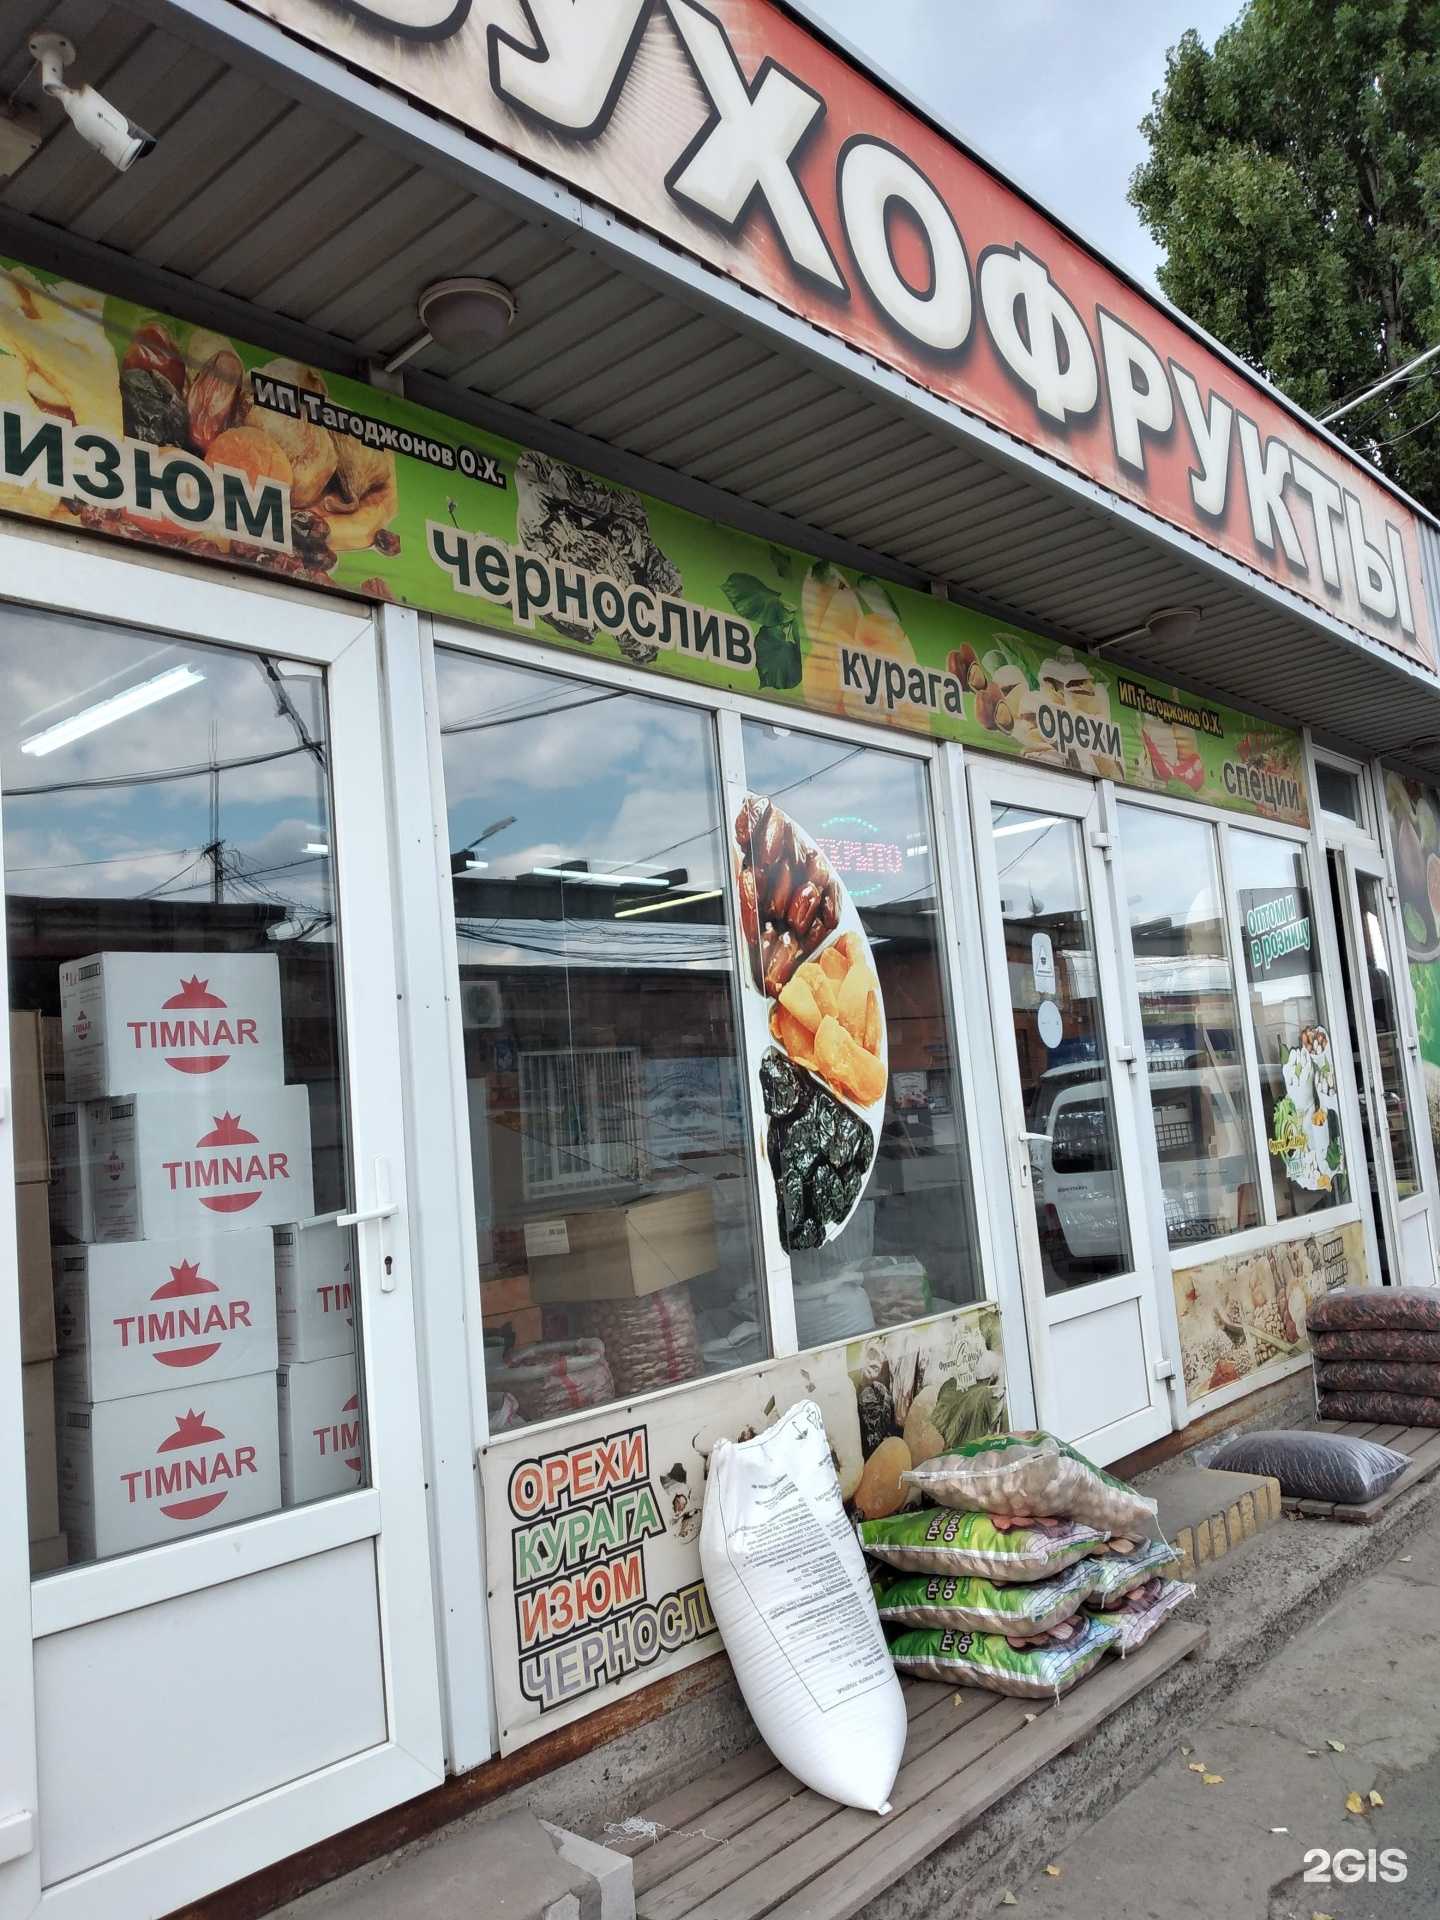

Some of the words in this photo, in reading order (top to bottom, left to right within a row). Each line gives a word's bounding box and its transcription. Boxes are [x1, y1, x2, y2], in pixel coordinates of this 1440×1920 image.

[325, 0, 1418, 639] УХОФРУКТЫ
[255, 378, 298, 414] ИП
[303, 394, 455, 468] Тагоджонов
[841, 648, 963, 715] курага
[1119, 680, 1137, 706] ИП
[1137, 688, 1201, 728] Тагоджонов
[1037, 703, 1122, 758] орехи
[1223, 762, 1300, 812] специи
[126, 1018, 259, 1049] TIMNAR
[162, 1152, 291, 1190] TIMNAR
[112, 1300, 253, 1347] TIMNAR
[120, 1446, 258, 1503] TIMNAR
[512, 1430, 647, 1516] ОРЕХИ
[516, 1487, 661, 1583] КУРАГА
[519, 1550, 644, 1648] ИЗЮМ
